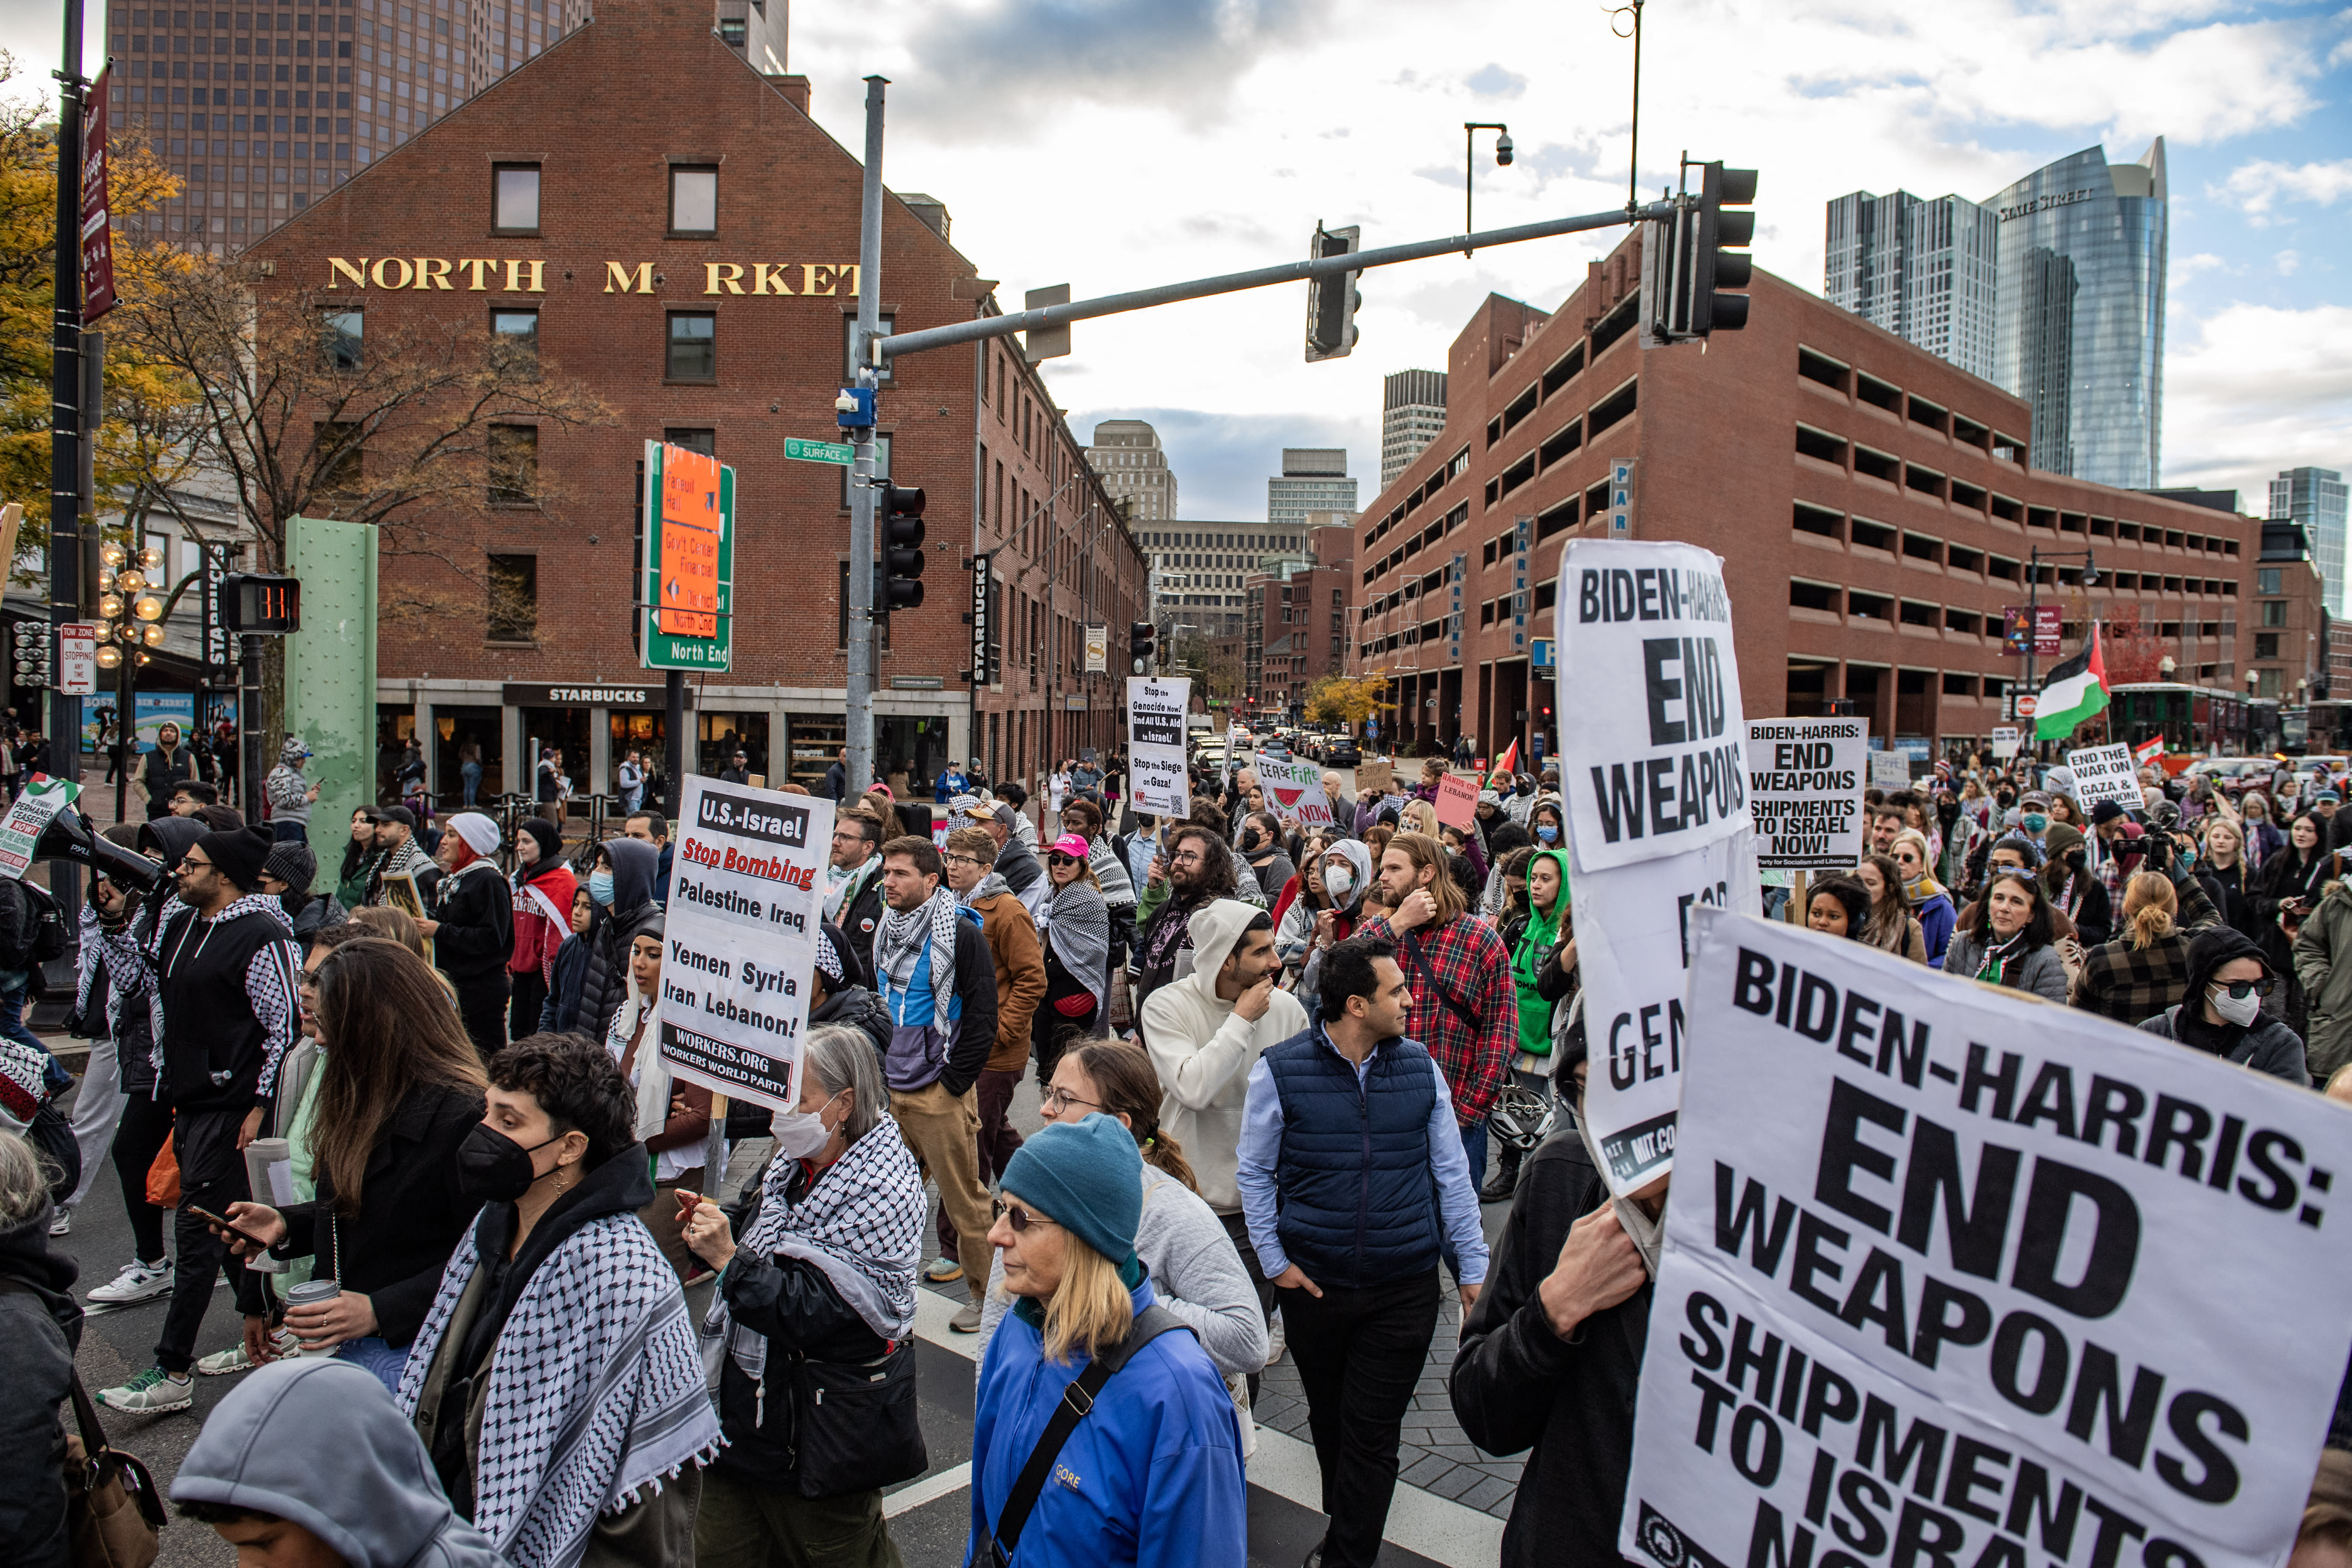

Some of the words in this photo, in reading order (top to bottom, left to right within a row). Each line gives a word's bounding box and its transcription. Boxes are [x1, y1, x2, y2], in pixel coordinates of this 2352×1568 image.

[327, 258, 546, 291] NORTH
[803, 446, 841, 460] SURFACE
[667, 471, 695, 495] Faneuil
[666, 492, 681, 512] Hall
[666, 533, 686, 553] Gov't
[690, 538, 714, 558] Center
[680, 556, 713, 578] Financial
[1515, 522, 1527, 645] PARKING
[687, 590, 713, 609] District
[1451, 556, 1462, 657] PARKING
[674, 612, 695, 629] North
[699, 614, 713, 631] End
[974, 558, 985, 681] STARBUCKS
[63, 628, 76, 636] TOW
[78, 628, 93, 637] ZONE
[65, 651, 93, 661] STOPPING
[74, 642, 82, 651] NO
[672, 642, 703, 661] North
[708, 645, 727, 663] End
[1087, 641, 1105, 660] 8
[550, 689, 646, 703] STARBUCKS
[1144, 686, 1159, 698] Stop
[1643, 636, 1726, 746] END
[1133, 701, 1165, 712] Genocide
[1167, 704, 1182, 713] Now!
[1133, 716, 1145, 724] End
[1145, 716, 1154, 725] All
[1155, 716, 1168, 727] U.S.
[1170, 719, 1181, 728] Aid
[1149, 731, 1172, 743] Israel!
[1750, 725, 1859, 740] BIDEN-HARRIS:
[1134, 757, 1150, 771] Stop
[1161, 760, 1182, 774] Siege
[1775, 743, 1834, 770] END
[1873, 754, 1908, 771] ISRAEL
[2071, 753, 2098, 765] END
[2101, 748, 2127, 761] THE
[1365, 765, 1383, 777] STOP
[2074, 764, 2108, 779] WAR
[2111, 761, 2130, 773] ON
[1151, 776, 1171, 788] Gaza!
[1360, 776, 1388, 790] GENOCIDE
[1442, 773, 1465, 787] HANDS
[1467, 783, 1480, 793] OFF
[1750, 770, 1856, 791] WEAPONS
[2080, 781, 2118, 795] GAZA
[2121, 780, 2132, 789] &
[1135, 791, 1145, 802] WWP
[1444, 786, 1474, 802] LEBANON
[1590, 741, 1744, 844] WEAPONS
[1298, 804, 1331, 823] NOW
[1751, 799, 1855, 817] SHIPMENTS
[12, 810, 47, 826] CEASEFIR
[702, 801, 803, 840] U.S.-Israel
[1753, 817, 1777, 834] TO
[1783, 817, 1850, 835] ISRAEL
[13, 822, 36, 835] NOW!
[1772, 836, 1829, 855] NOW!
[682, 837, 721, 867] Stop
[723, 847, 816, 891] Bombing
[1162, 957, 1174, 967] THE
[742, 962, 797, 997] Syria
[705, 992, 798, 1038] Lebanon!
[676, 1028, 769, 1073] WORKERS.ORG
[662, 1042, 706, 1068] WORKERS
[708, 1061, 748, 1082] WORLD
[750, 1074, 787, 1095] PARTY
[1732, 945, 2334, 1230] BIDEN-HARRIS:
[1630, 1132, 1656, 1165] MIT
[1814, 1075, 2142, 1321] END
[1713, 1159, 2250, 1505] WEAPONS
[1691, 1369, 1784, 1490] TO
[1056, 1464, 1081, 1489] GORE
